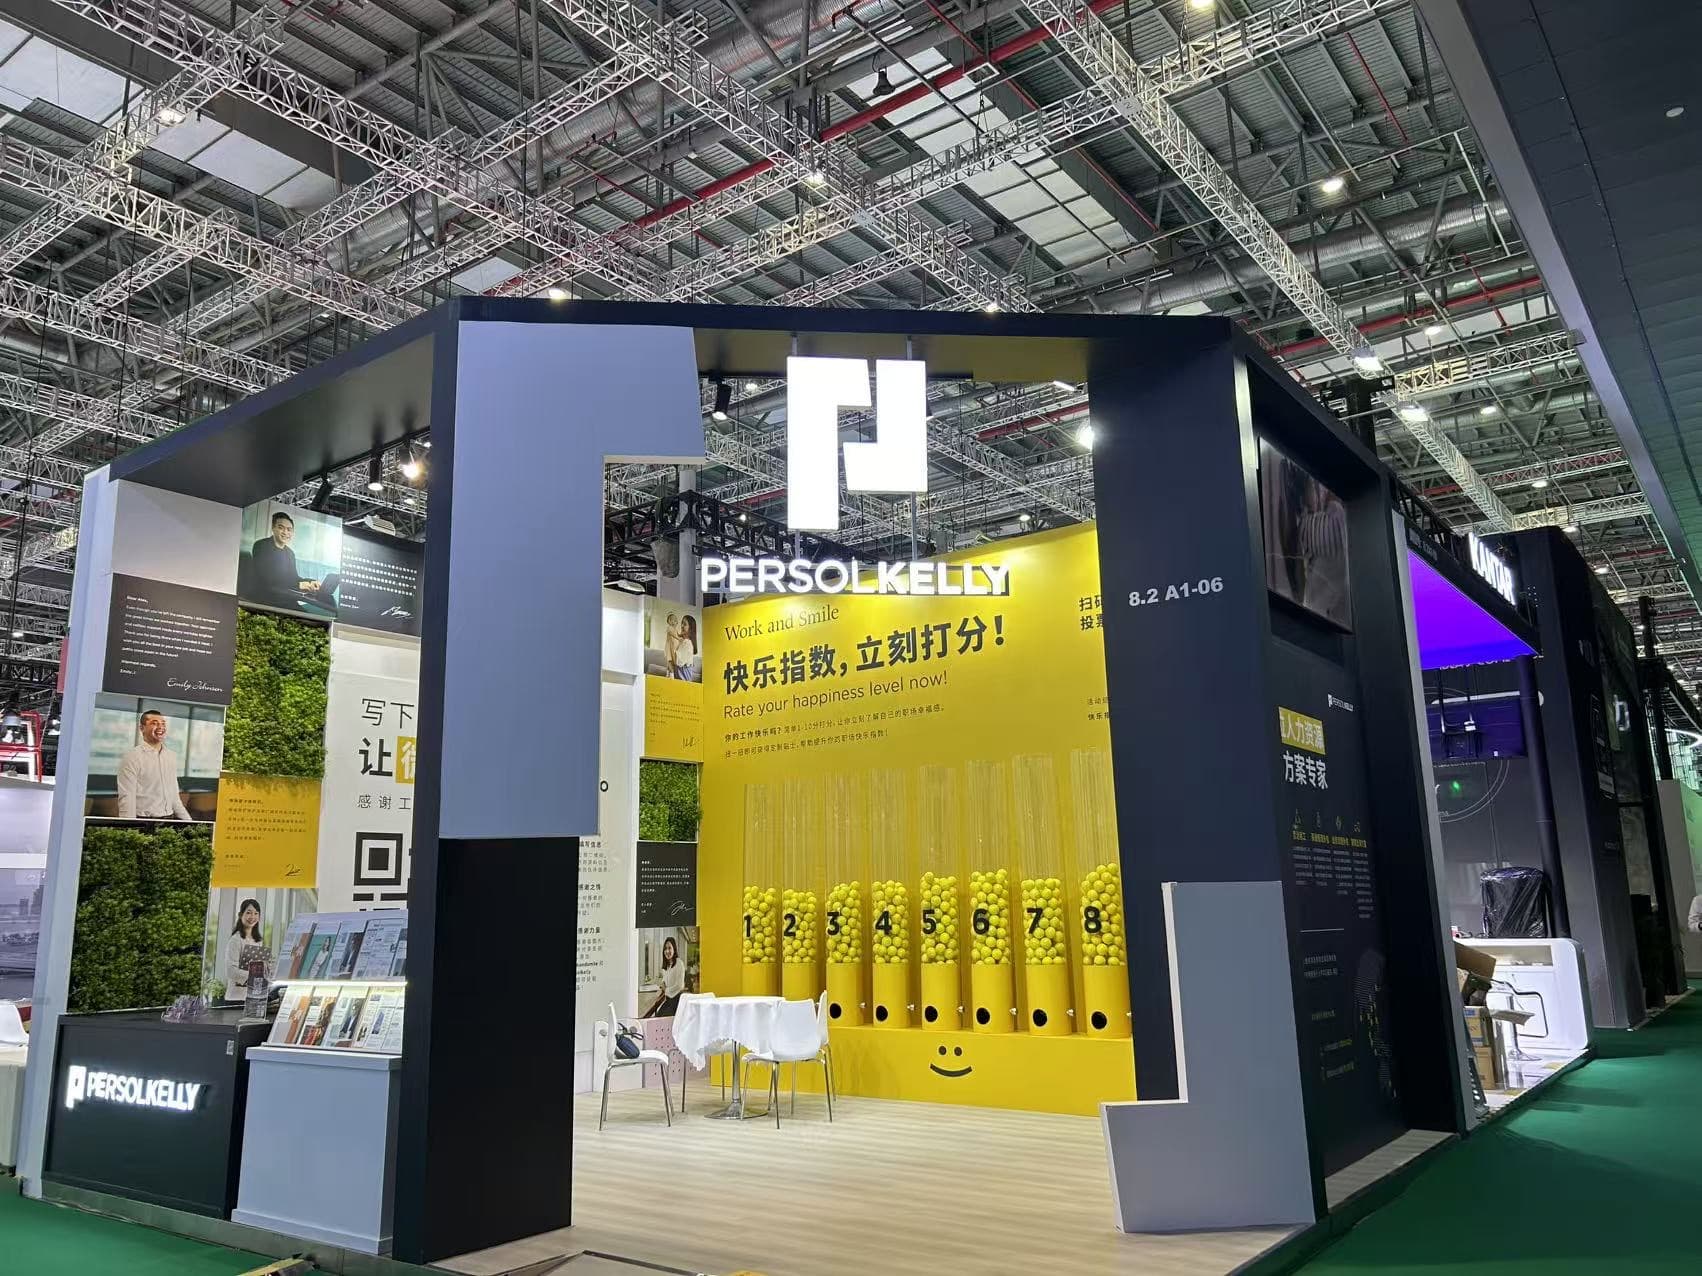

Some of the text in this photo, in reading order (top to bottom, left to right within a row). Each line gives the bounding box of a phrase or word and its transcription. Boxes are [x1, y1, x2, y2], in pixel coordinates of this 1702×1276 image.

[701, 558, 1009, 596] PERSOLKELLY
[1129, 577, 1223, 606] 8.2 A1-06
[725, 604, 839, 640] Work and Smile
[723, 614, 1005, 696] 快乐指数，立刻打分！
[361, 698, 415, 729] 写下
[724, 704, 754, 719] Rate
[758, 699, 788, 717] your
[793, 687, 865, 708] happiness
[869, 677, 904, 696] level
[909, 670, 947, 690] now!
[1283, 750, 1328, 790] 方案专家
[743, 905, 1103, 937] 1 2 3 4 5 6 7 8
[87, 1071, 201, 1111] PERSOLKELLY
